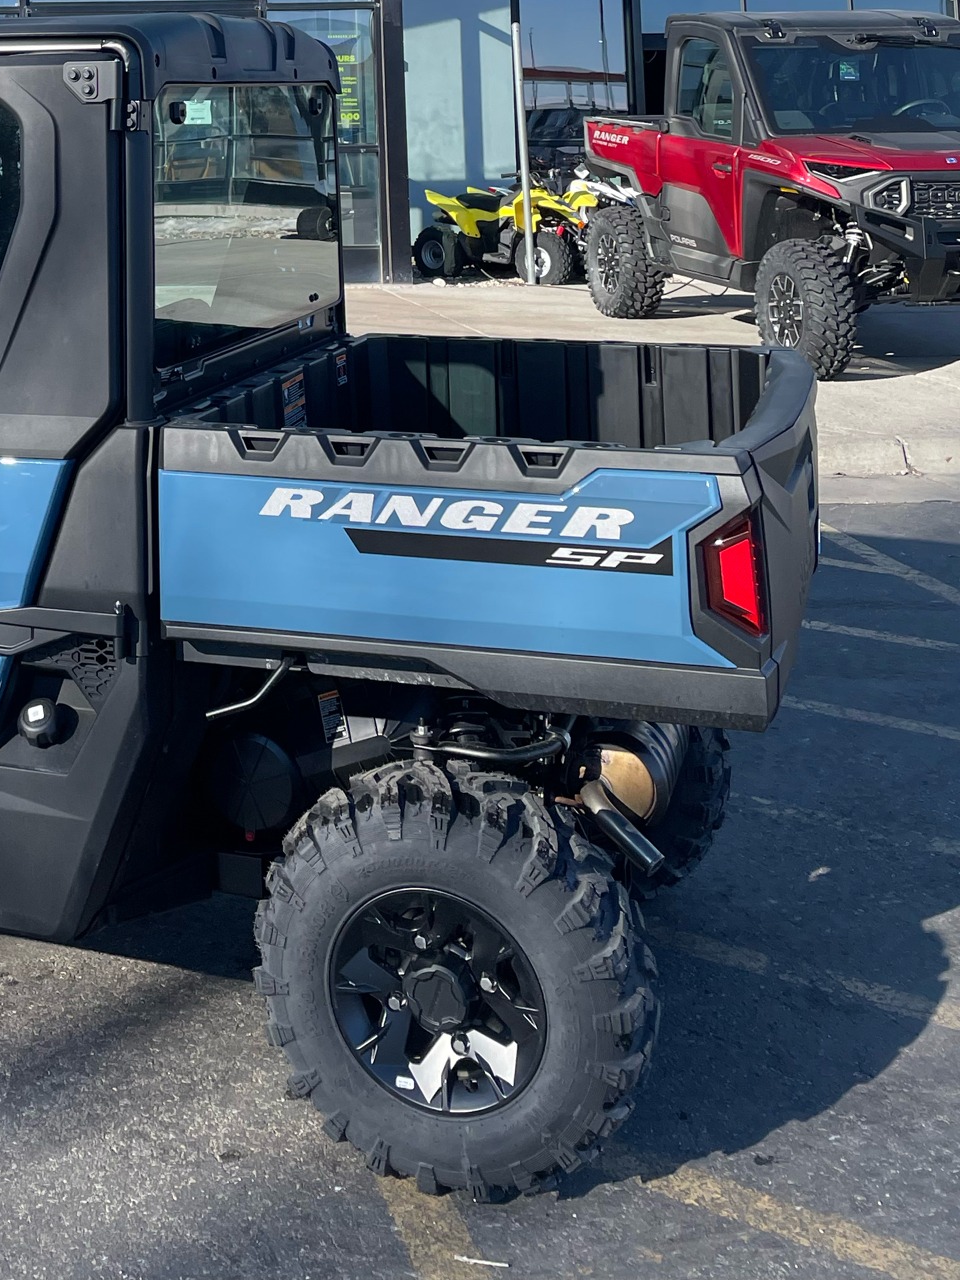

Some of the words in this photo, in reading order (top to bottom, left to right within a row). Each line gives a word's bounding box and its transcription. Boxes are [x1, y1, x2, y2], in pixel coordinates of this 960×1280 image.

[593, 130, 629, 145] RANGER
[748, 152, 782, 166] 1500
[669, 233, 698, 248] POLARIS
[258, 487, 635, 540] RANGER
[546, 548, 664, 569] SP
